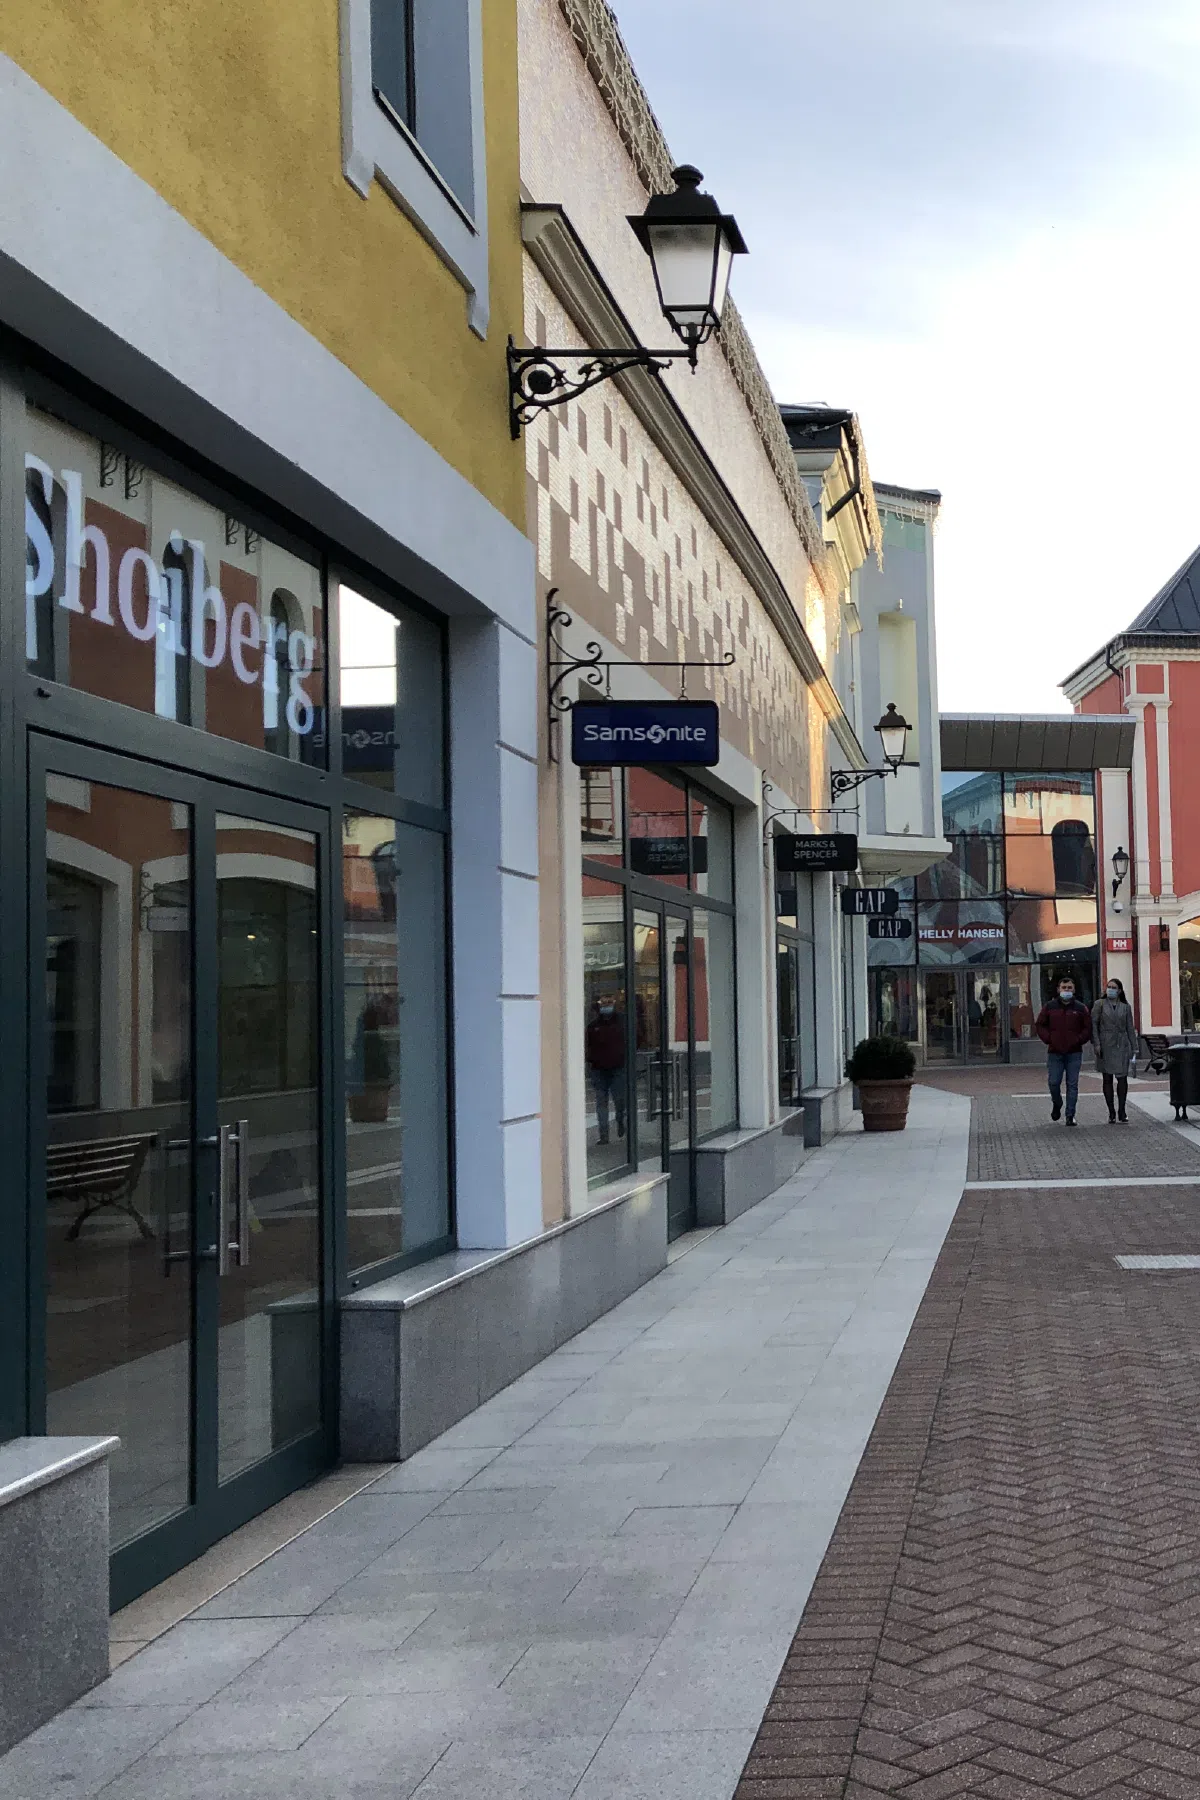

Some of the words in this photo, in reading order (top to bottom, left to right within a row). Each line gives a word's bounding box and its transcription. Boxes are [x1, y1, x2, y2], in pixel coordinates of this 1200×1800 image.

[584, 724, 707, 744] Samsonite
[795, 840, 828, 848] MARKS
[829, 840, 836, 848] &
[793, 850, 839, 859] SPENCER
[855, 891, 886, 913] GAP
[878, 920, 901, 937] GAP
[918, 929, 954, 939] HELLY
[958, 928, 1004, 938] HANSEN
[1113, 940, 1127, 948] HH
